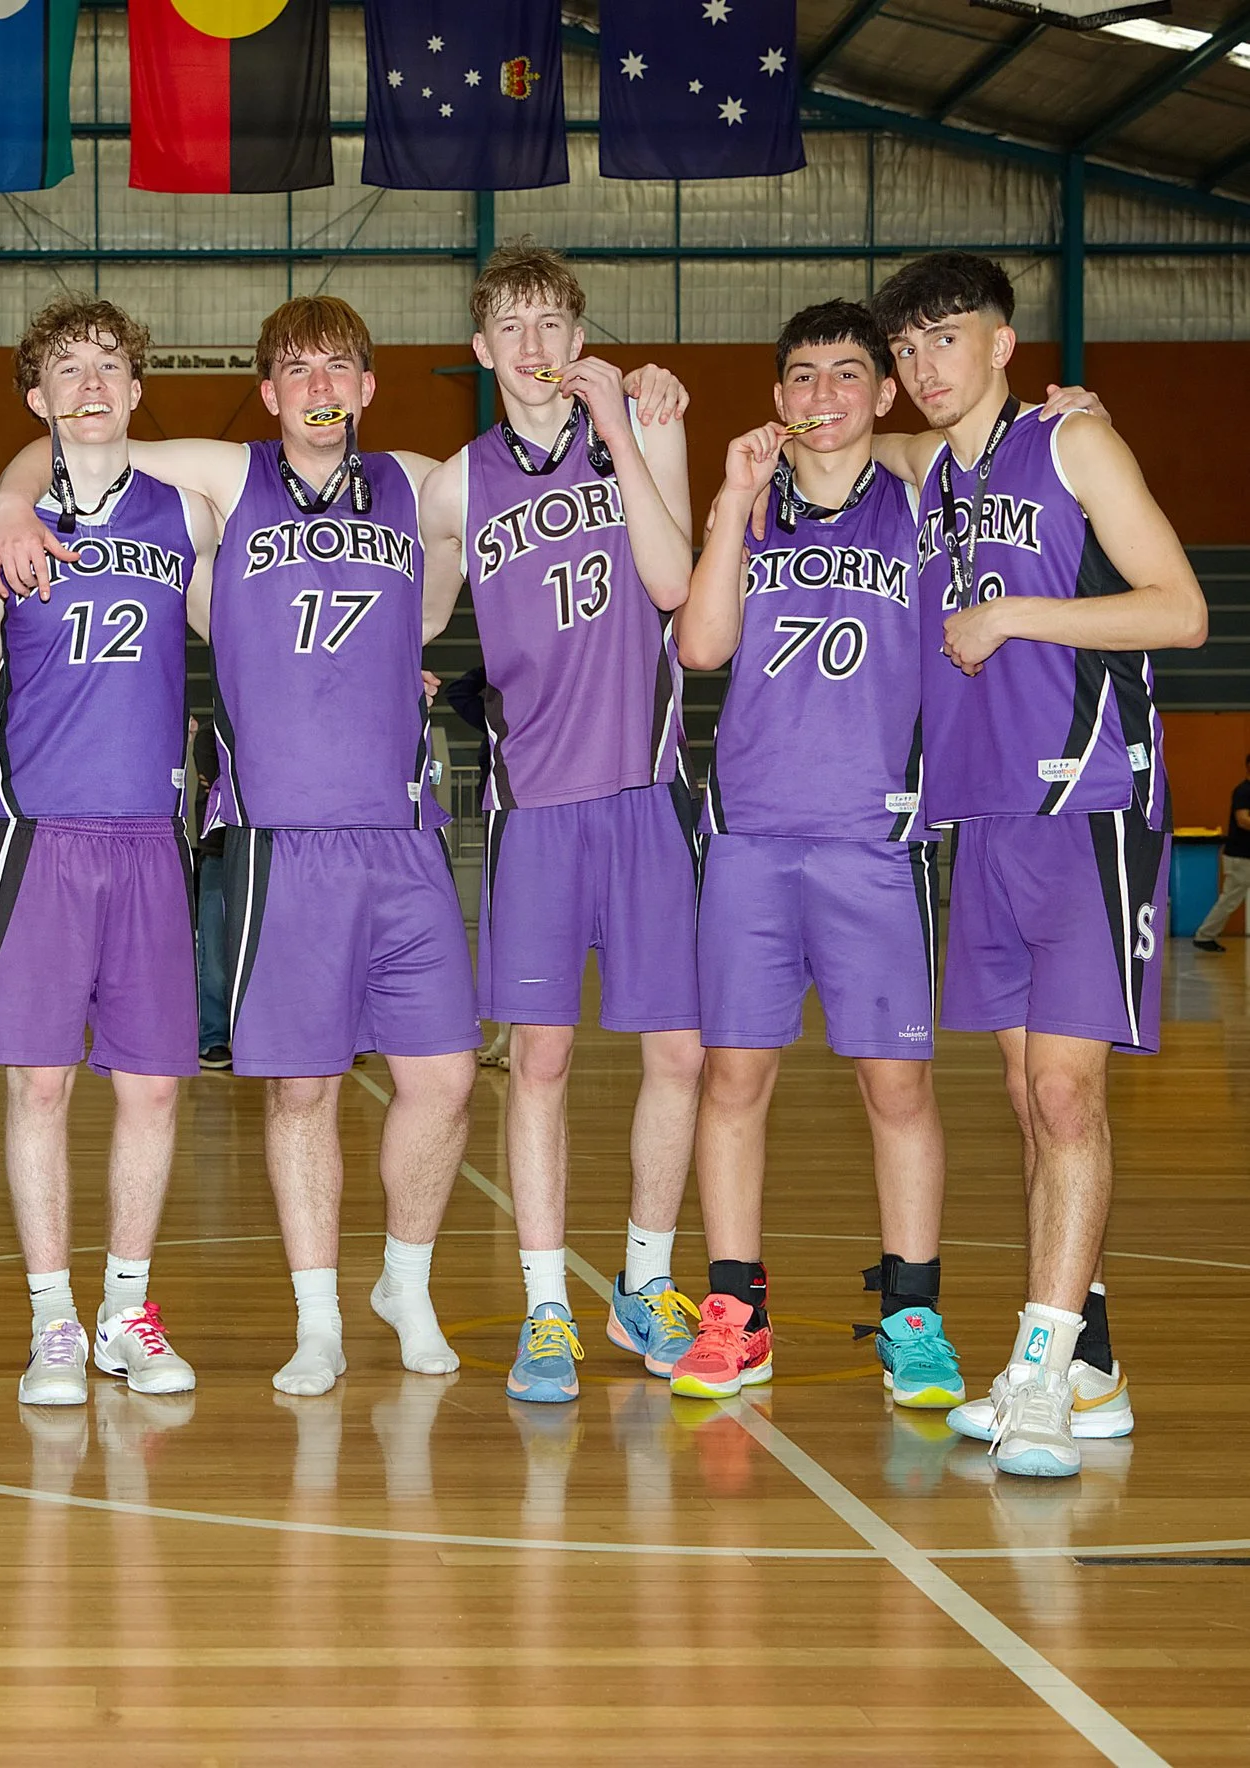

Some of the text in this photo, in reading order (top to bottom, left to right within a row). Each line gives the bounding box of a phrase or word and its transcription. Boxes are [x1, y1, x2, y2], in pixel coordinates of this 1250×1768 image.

[512, 445, 534, 472] PACERS
[551, 429, 571, 463] PACERS
[987, 420, 1008, 455] PACERS
[60, 478, 73, 515] PACERS
[287, 478, 309, 507] PACERS
[321, 470, 343, 503] PACERS
[353, 476, 364, 511] PACERS
[243, 518, 415, 583] STORM
[475, 477, 627, 584] STOR
[15, 537, 185, 607] TORM
[541, 549, 613, 632] 13
[951, 556, 963, 593] PACERS
[61, 599, 148, 665] 12
[290, 589, 383, 654] 17
[762, 616, 868, 681] 70
[1133, 903, 1157, 962] S
